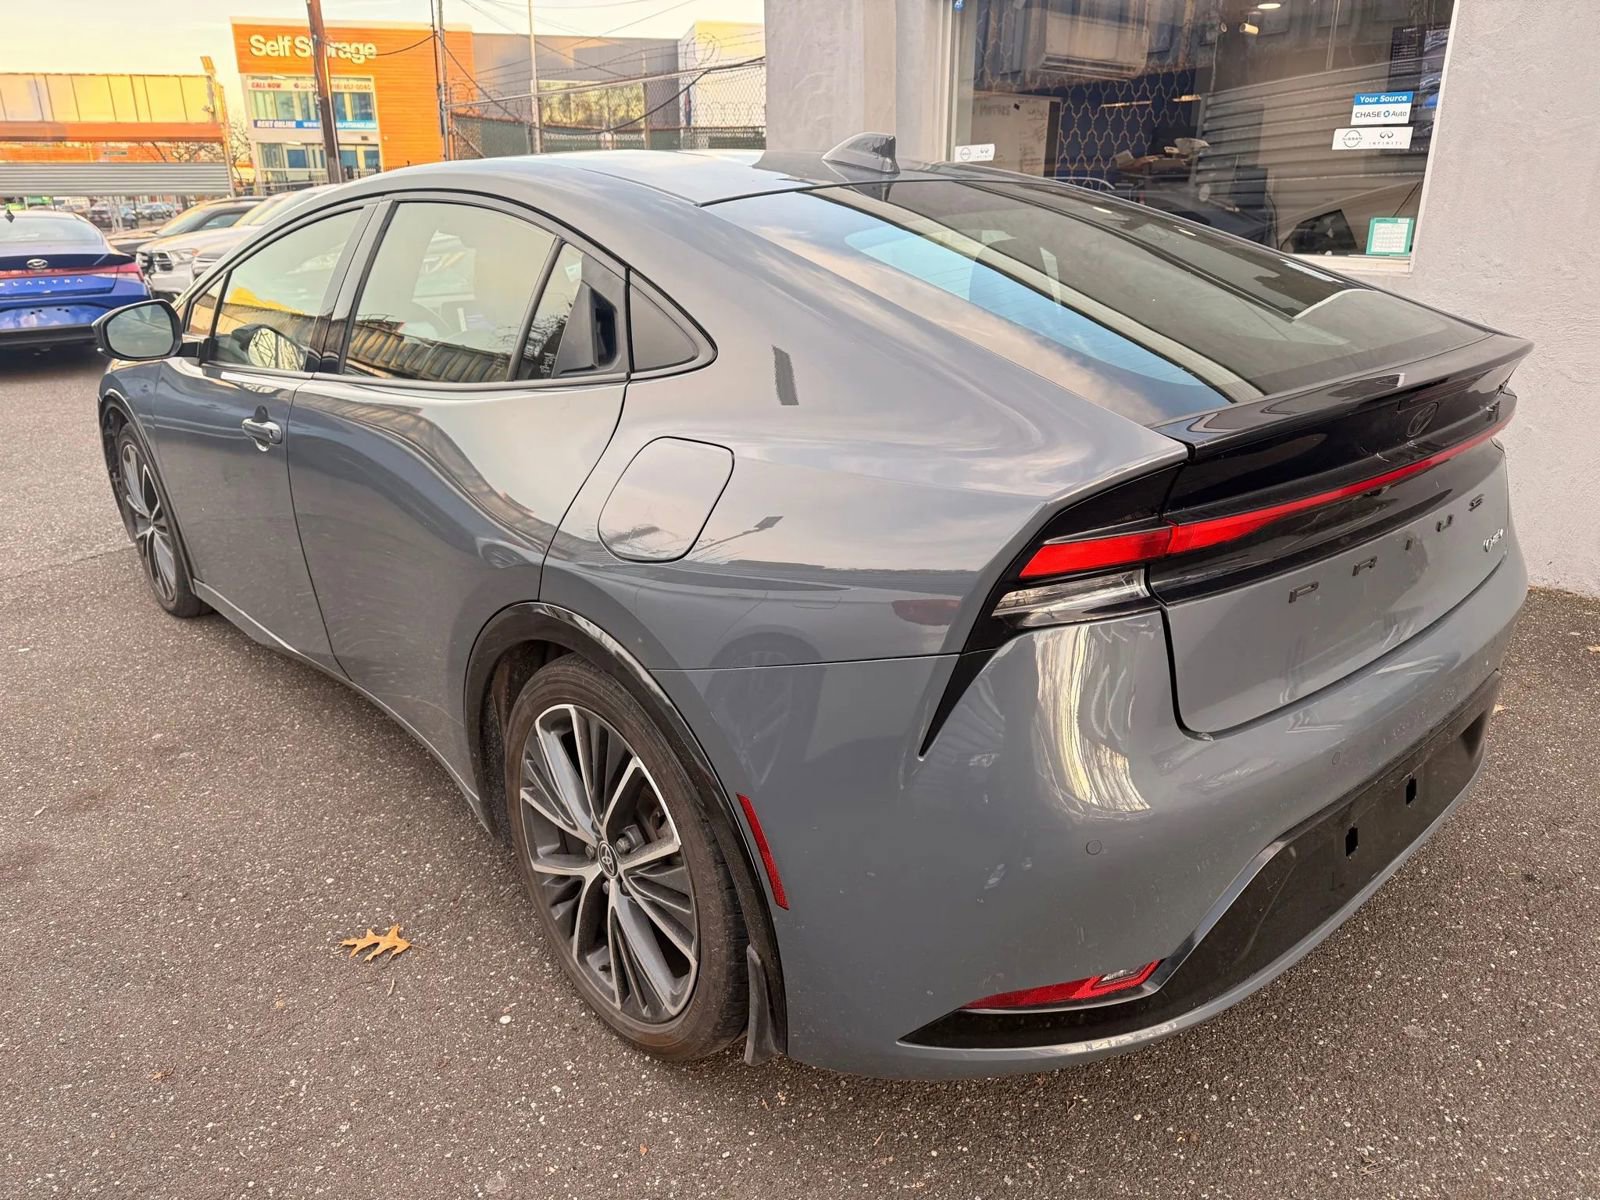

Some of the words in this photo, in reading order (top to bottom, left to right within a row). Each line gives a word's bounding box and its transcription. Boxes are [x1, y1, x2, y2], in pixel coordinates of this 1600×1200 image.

[249, 34, 292, 57] Self
[1360, 95, 1378, 104] Your
[1380, 94, 1407, 103] Source
[1355, 110, 1382, 119] CHASE
[1391, 110, 1407, 118] Auto
[1288, 493, 1485, 604] PRIUS
